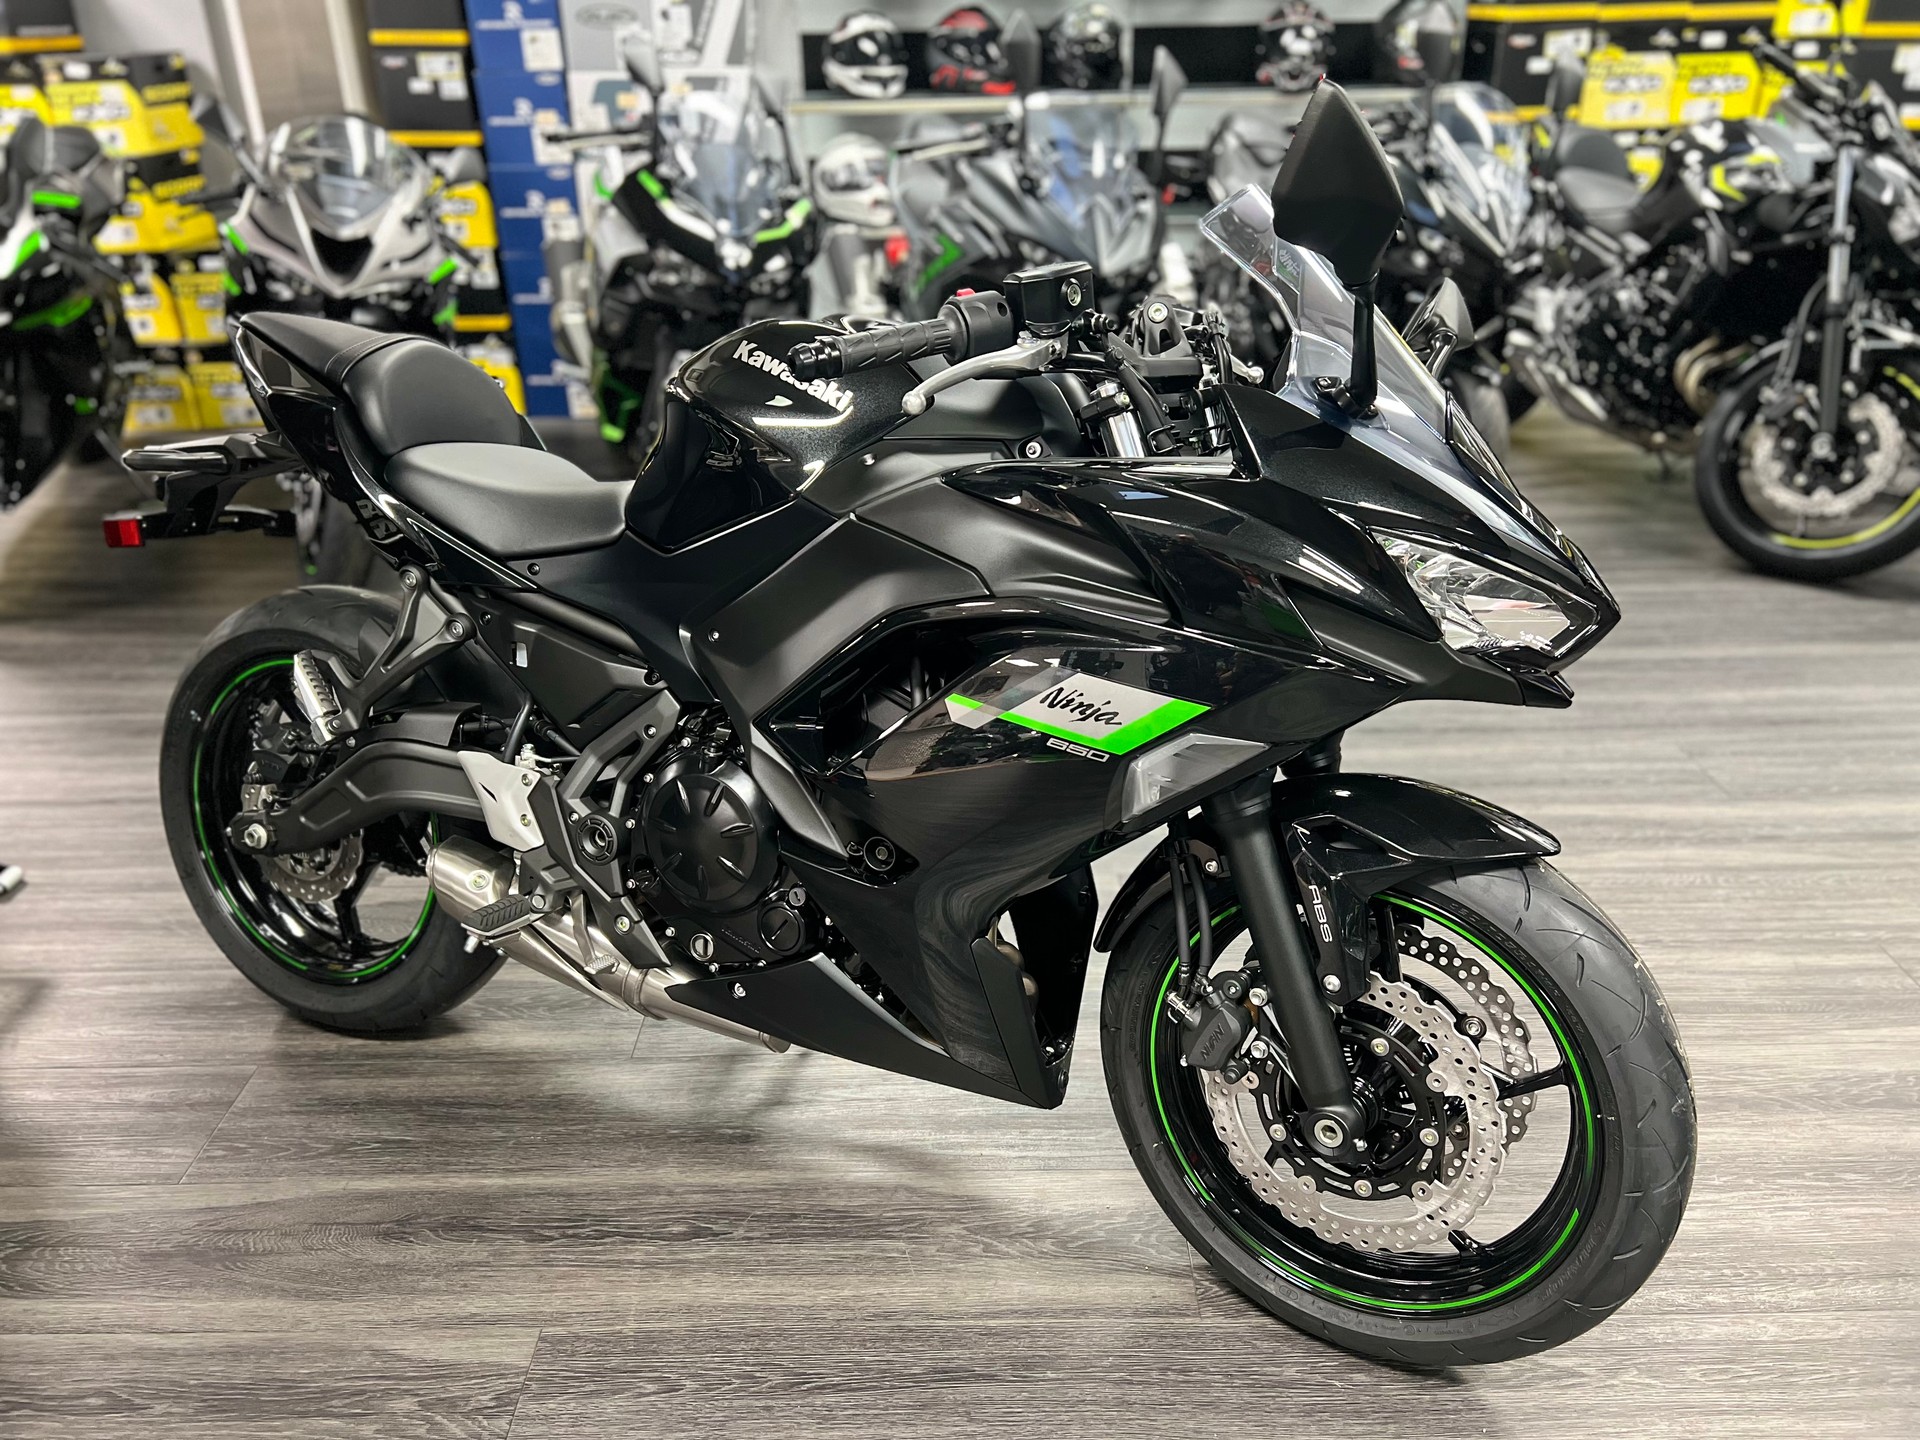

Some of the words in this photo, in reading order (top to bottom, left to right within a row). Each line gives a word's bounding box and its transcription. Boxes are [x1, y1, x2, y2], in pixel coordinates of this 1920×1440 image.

[1039, 687, 1122, 725] Ninja
[1046, 738, 1110, 763] 650
[1308, 884, 1333, 943] ABS
